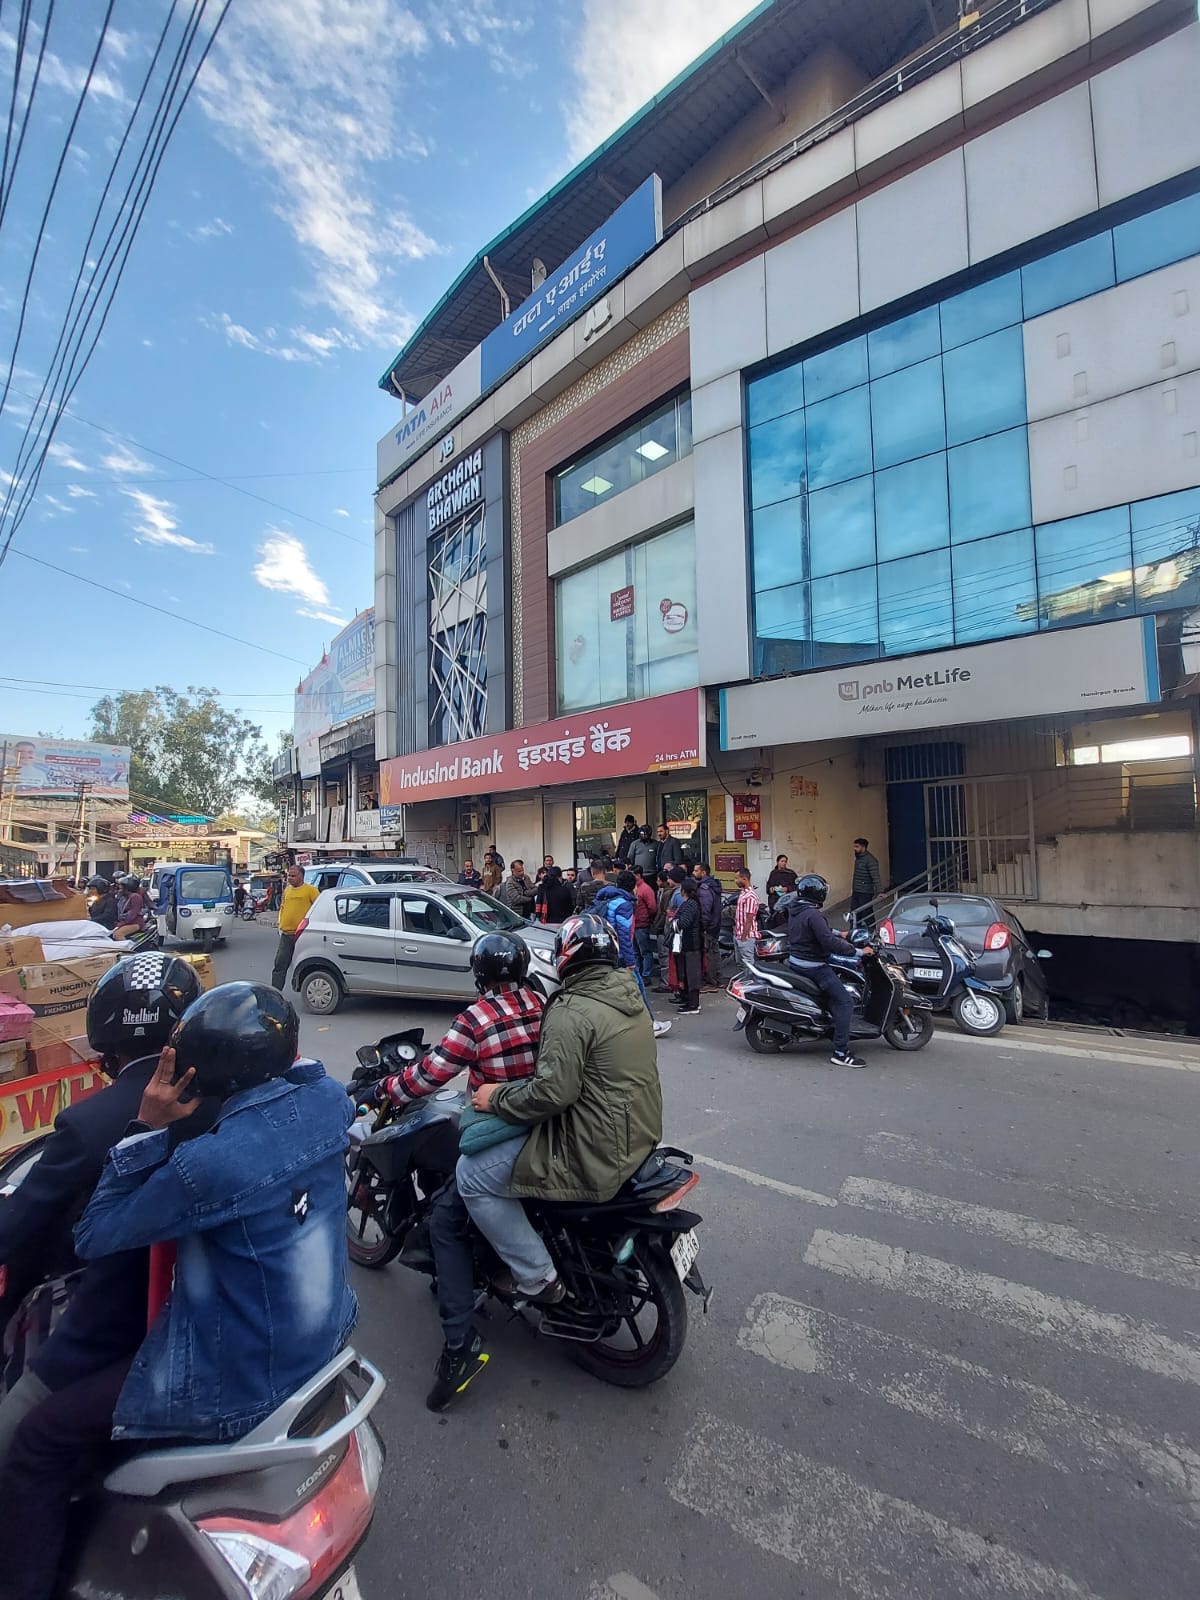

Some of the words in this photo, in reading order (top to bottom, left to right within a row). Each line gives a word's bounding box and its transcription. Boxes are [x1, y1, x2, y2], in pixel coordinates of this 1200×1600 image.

[395, 409, 427, 446] TATA
[430, 384, 453, 416] AIA
[439, 436, 454, 462] AB
[427, 447, 482, 508] ARCHANA
[428, 475, 481, 530] BHAWAN
[862, 680, 893, 699] pnb
[897, 667, 971, 691] MetLife
[400, 756, 458, 789] IndusInd
[461, 752, 504, 780] Bank
[517, 730, 586, 771] इंडसइंड
[590, 722, 632, 754] बैंक
[655, 754, 664, 763] 24
[665, 753, 679, 761] hrs
[680, 749, 697, 760] ATM
[44, 1004, 71, 1015] FRENCH
[122, 1006, 160, 1024] Steelbird
[296, 1453, 337, 1497] HONDA
